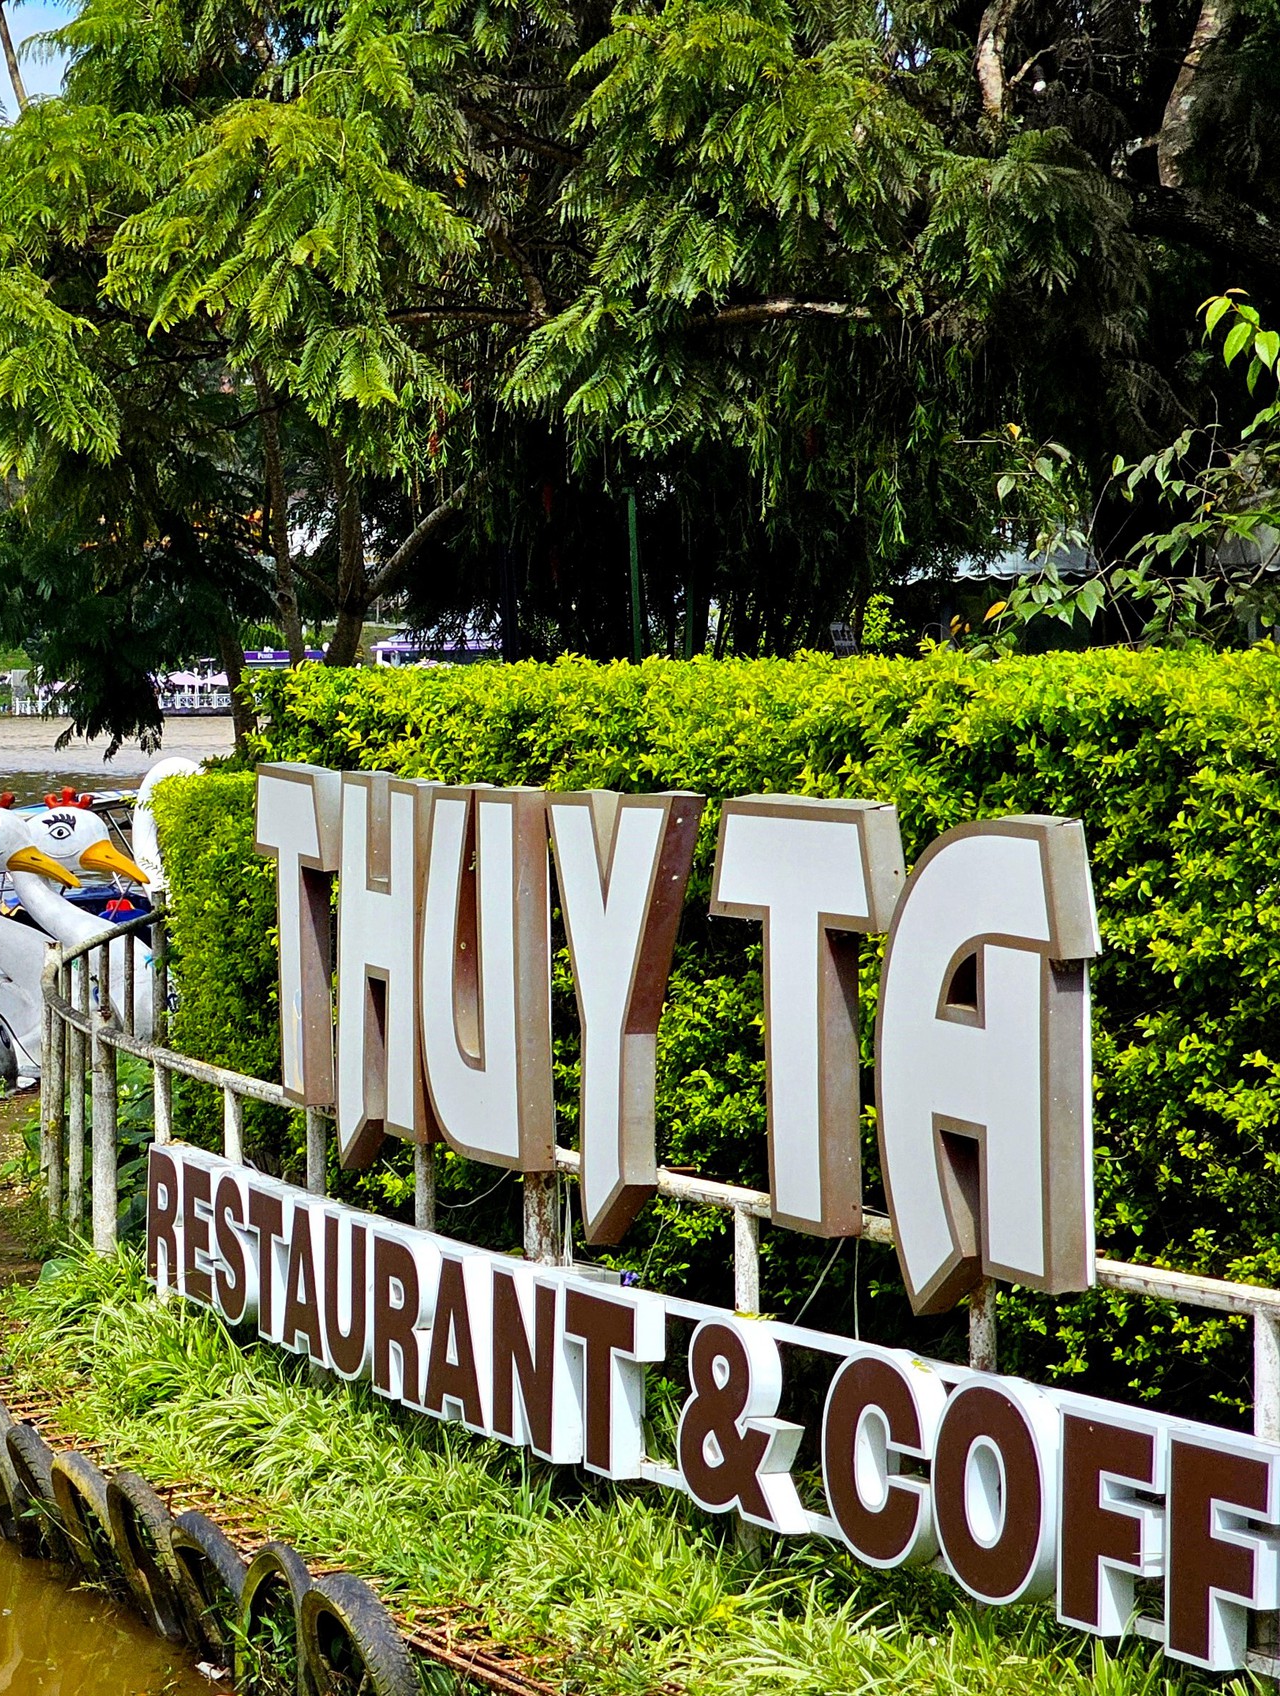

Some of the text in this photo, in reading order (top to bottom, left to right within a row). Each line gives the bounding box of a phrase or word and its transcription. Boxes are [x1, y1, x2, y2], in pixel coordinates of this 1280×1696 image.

[255, 762, 1102, 1317] THUY TA
[147, 1143, 1280, 1672] RESTAURANT & COFF
